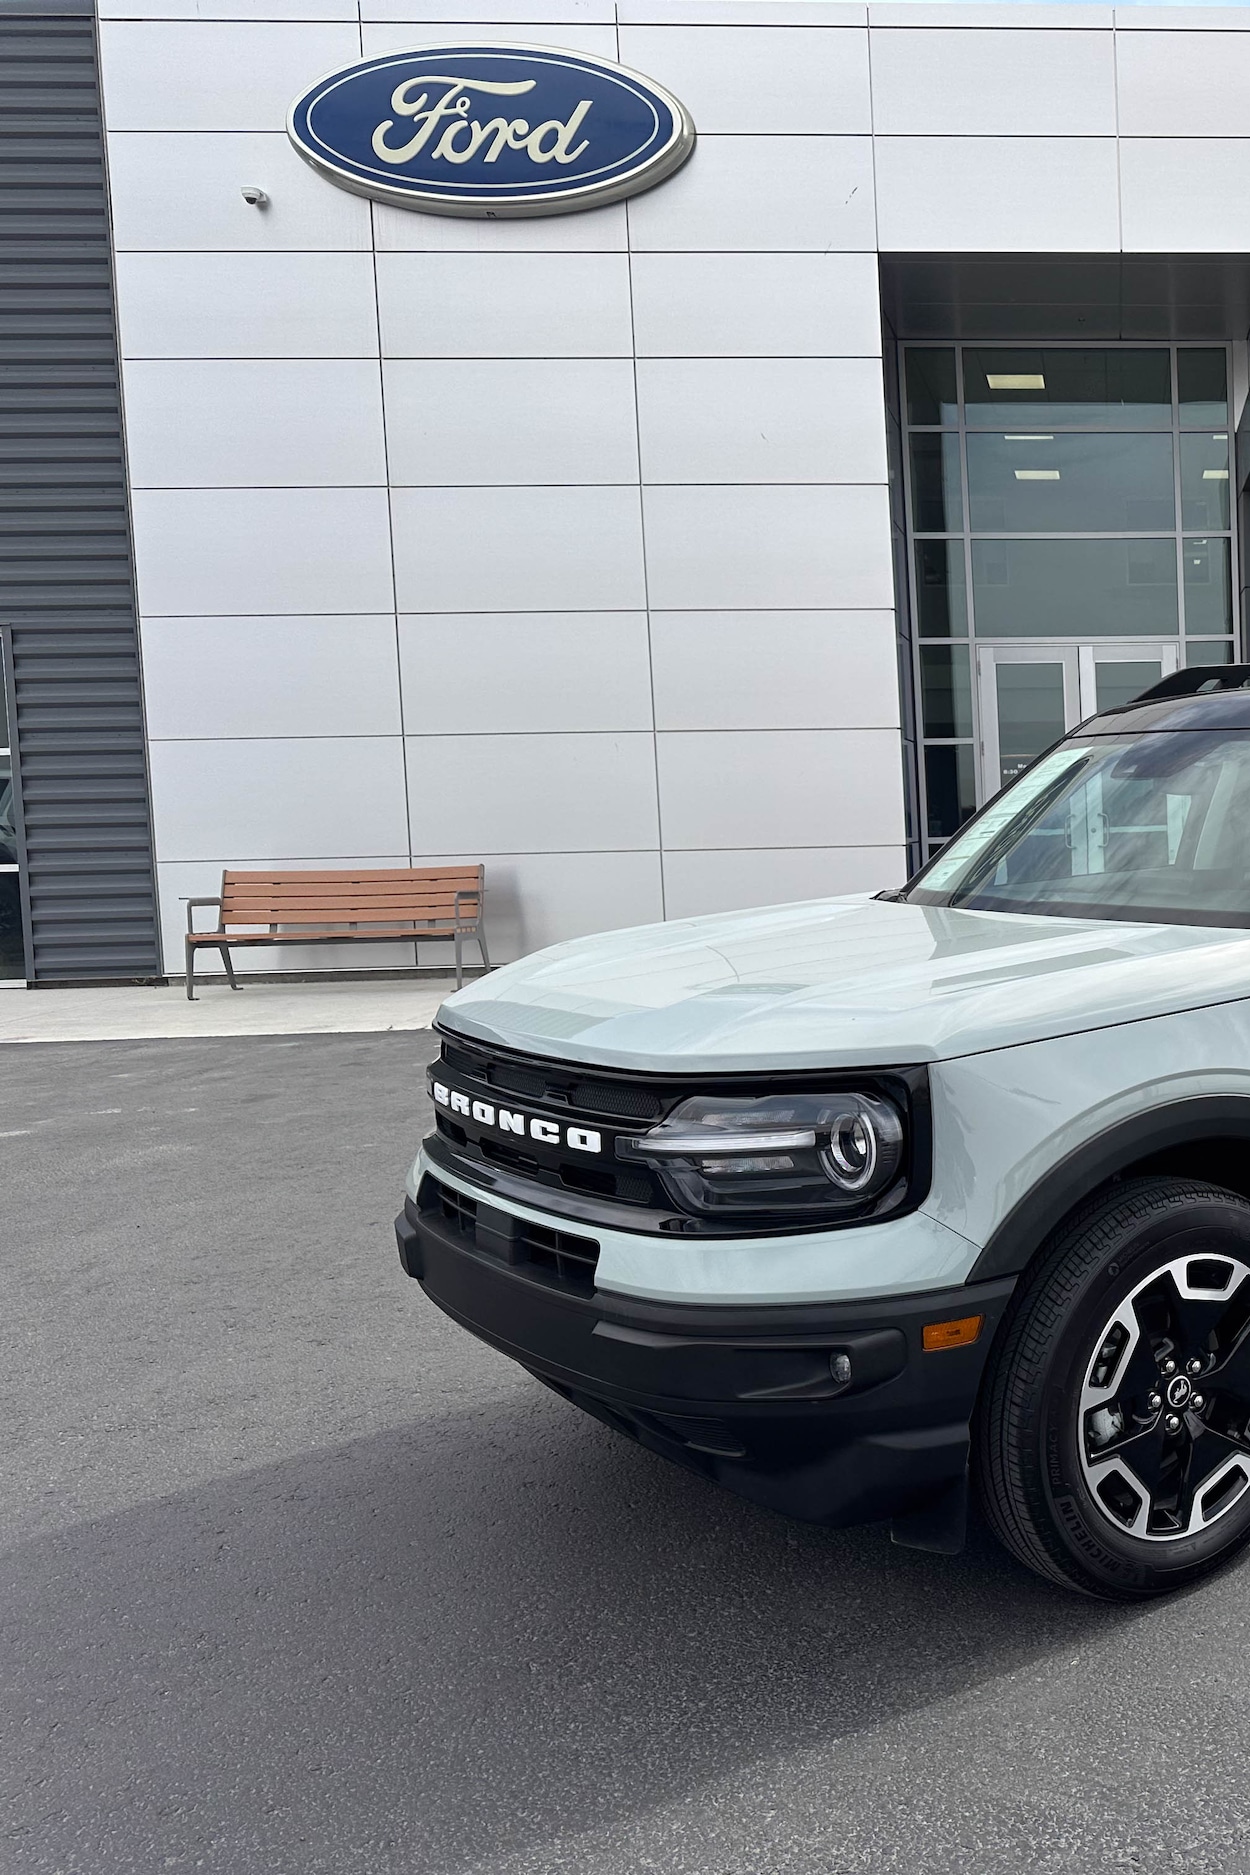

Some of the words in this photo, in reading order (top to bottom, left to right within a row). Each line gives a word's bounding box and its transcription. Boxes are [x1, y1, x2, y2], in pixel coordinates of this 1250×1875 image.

[372, 75, 594, 164] Ford
[434, 1081, 602, 1153] BRONCO
[1060, 1500, 1121, 1572] MICHELIN
